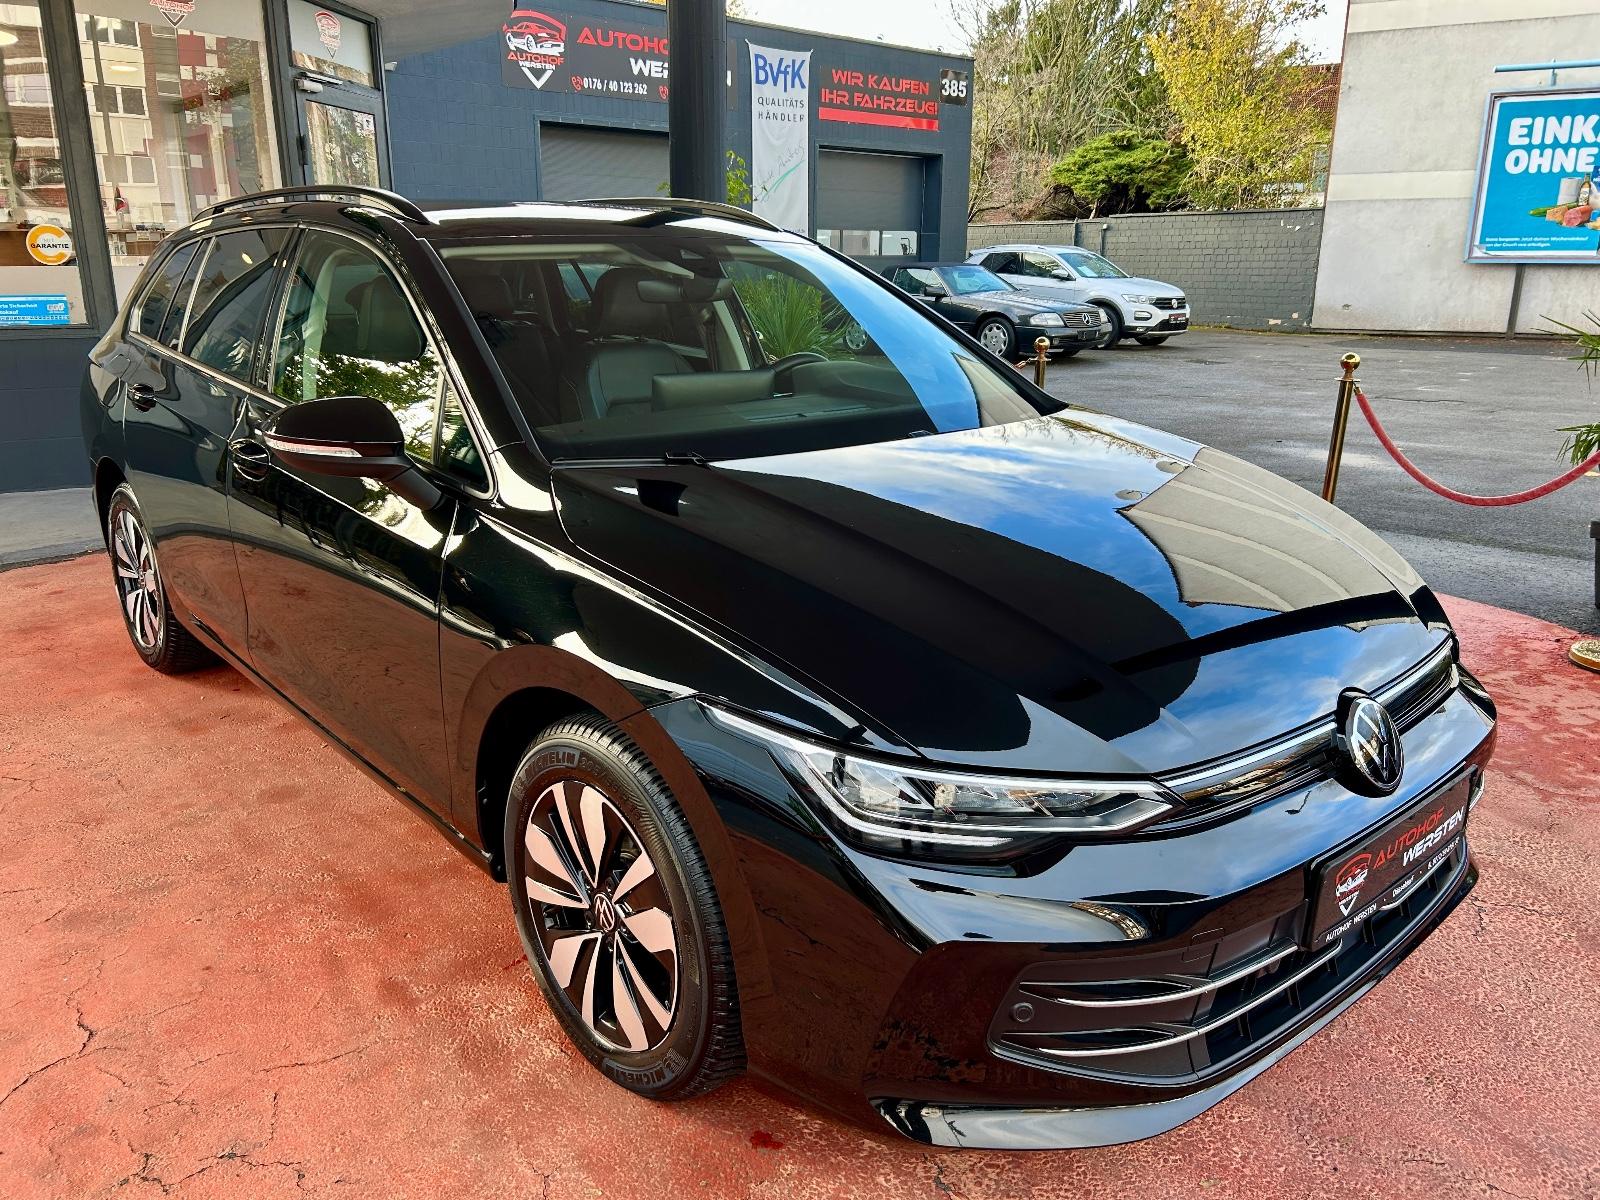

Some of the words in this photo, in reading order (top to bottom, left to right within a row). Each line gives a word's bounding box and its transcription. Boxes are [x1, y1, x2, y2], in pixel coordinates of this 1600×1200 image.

[577, 27, 668, 54] AUTOHO
[507, 51, 565, 65] AUTOHOF
[519, 60, 556, 70] WERSTEN
[583, 77, 602, 90] 0176
[608, 80, 618, 92] 40
[620, 81, 633, 94] 123
[634, 83, 648, 95] 262
[754, 53, 807, 93] BVfK
[831, 69, 863, 86] WIR
[867, 74, 930, 95] KAUFEN
[821, 88, 851, 105] IHR
[941, 79, 968, 98] 385
[757, 96, 805, 109] QUALITÄTS
[758, 110, 805, 123] HÄNDLER
[1508, 115, 1600, 146] EINK
[1504, 147, 1599, 175] OHNE
[524, 751, 577, 778] MICHELIN
[1374, 806, 1445, 870] AUTOHOF
[1403, 806, 1464, 867] WERSTEN
[1325, 918, 1352, 943] AUTOHOF
[1353, 903, 1377, 925] WERSTEN
